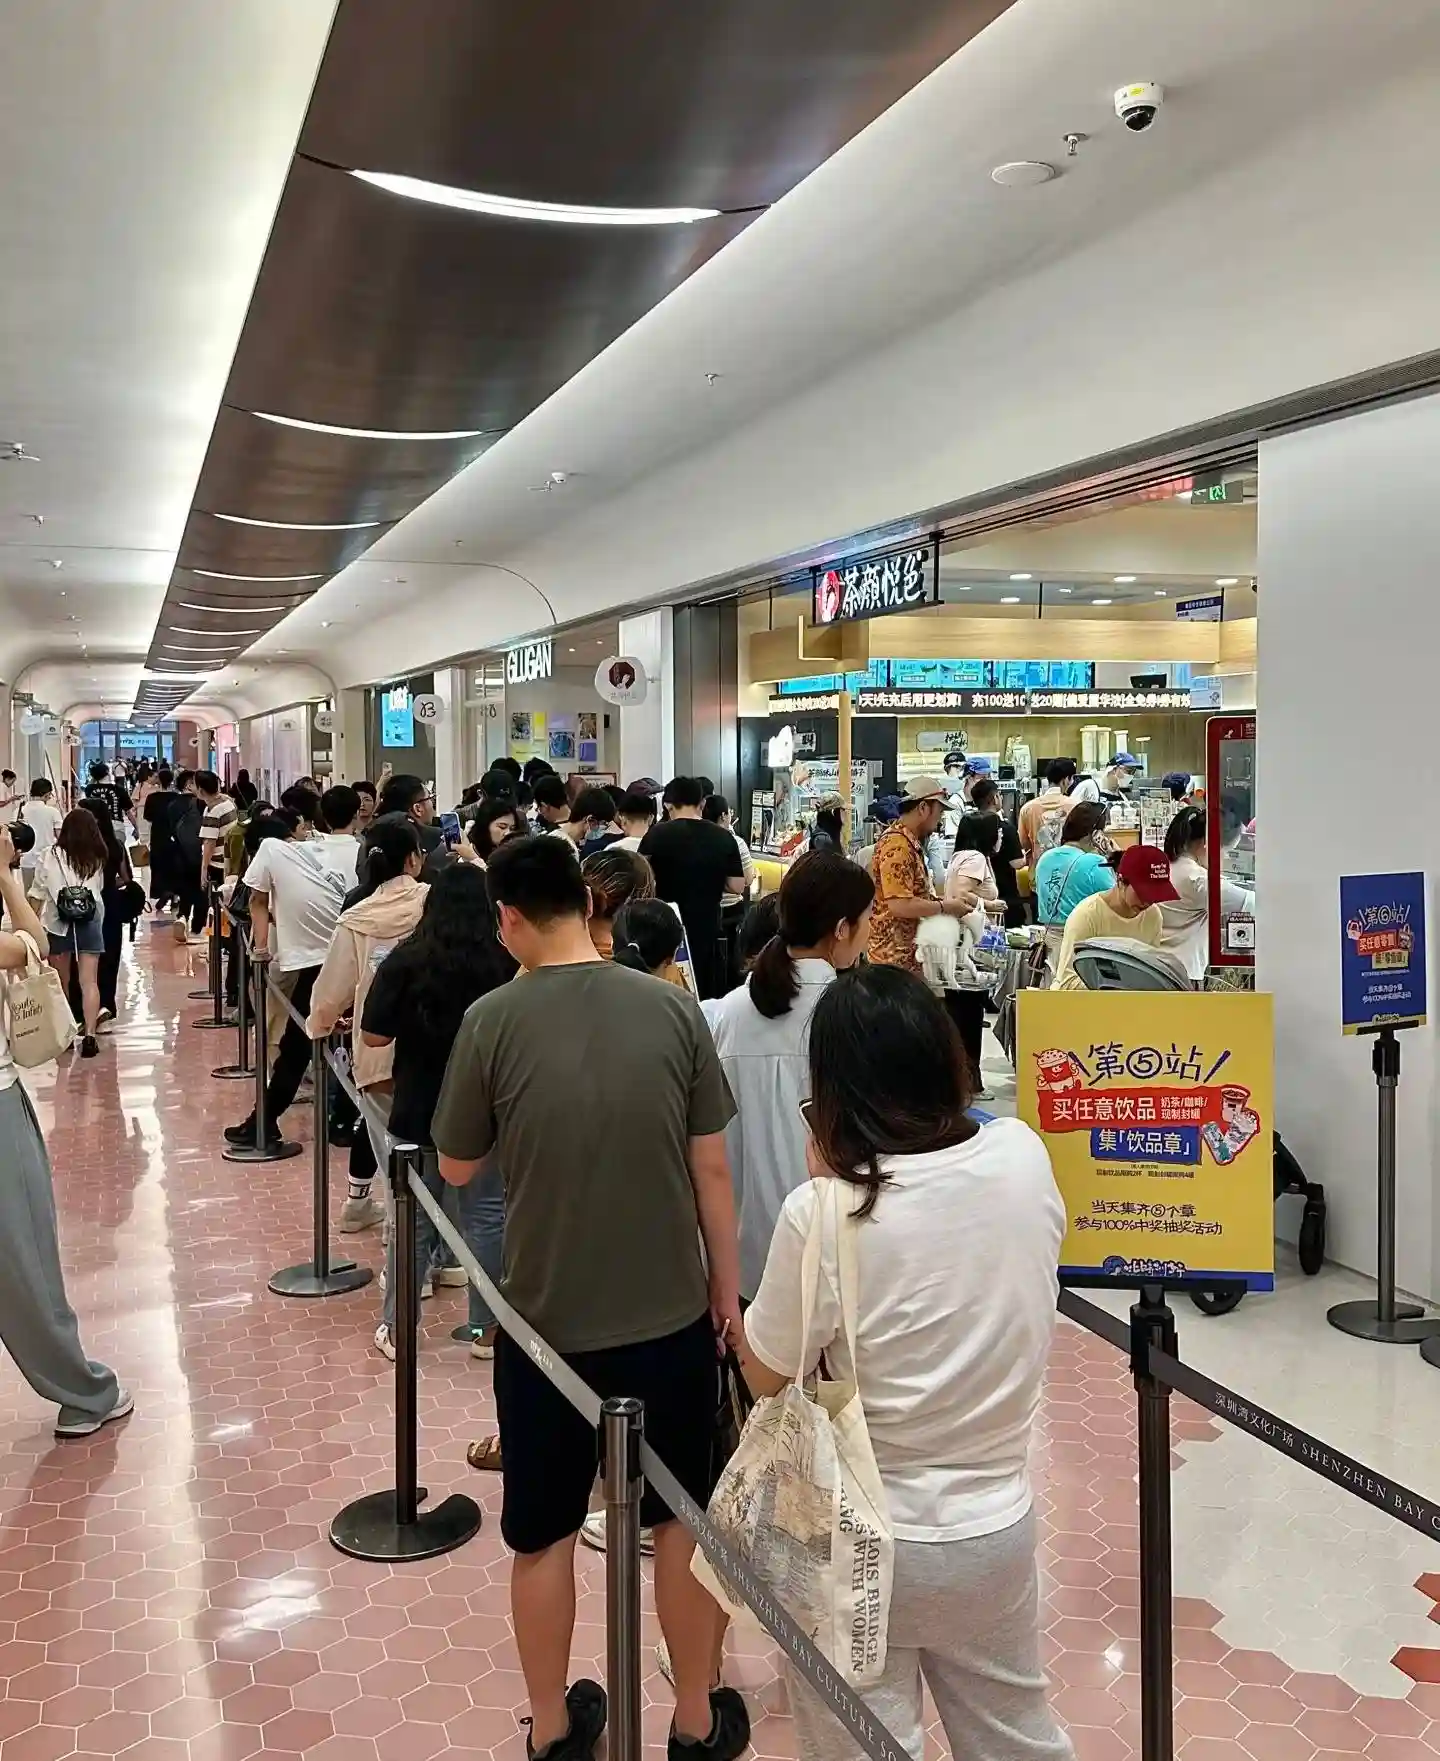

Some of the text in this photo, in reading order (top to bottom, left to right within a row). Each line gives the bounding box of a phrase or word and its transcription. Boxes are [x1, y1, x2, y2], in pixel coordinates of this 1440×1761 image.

[1052, 1097, 1156, 1122] 买任意饮品
[1075, 1216, 1223, 1235] 参与100%中奖抽奖活动
[1215, 1392, 1294, 1448] 深圳湾文化广场
[1301, 1442, 1387, 1500] SHENZHEN
[1394, 1494, 1425, 1521] BAY
[851, 1539, 867, 1592] WITH
[851, 1598, 867, 1674] WOMEN
[866, 1588, 881, 1665] BRIDGE
[791, 1633, 812, 1669] BAY
[815, 1666, 875, 1745] CULTURE
